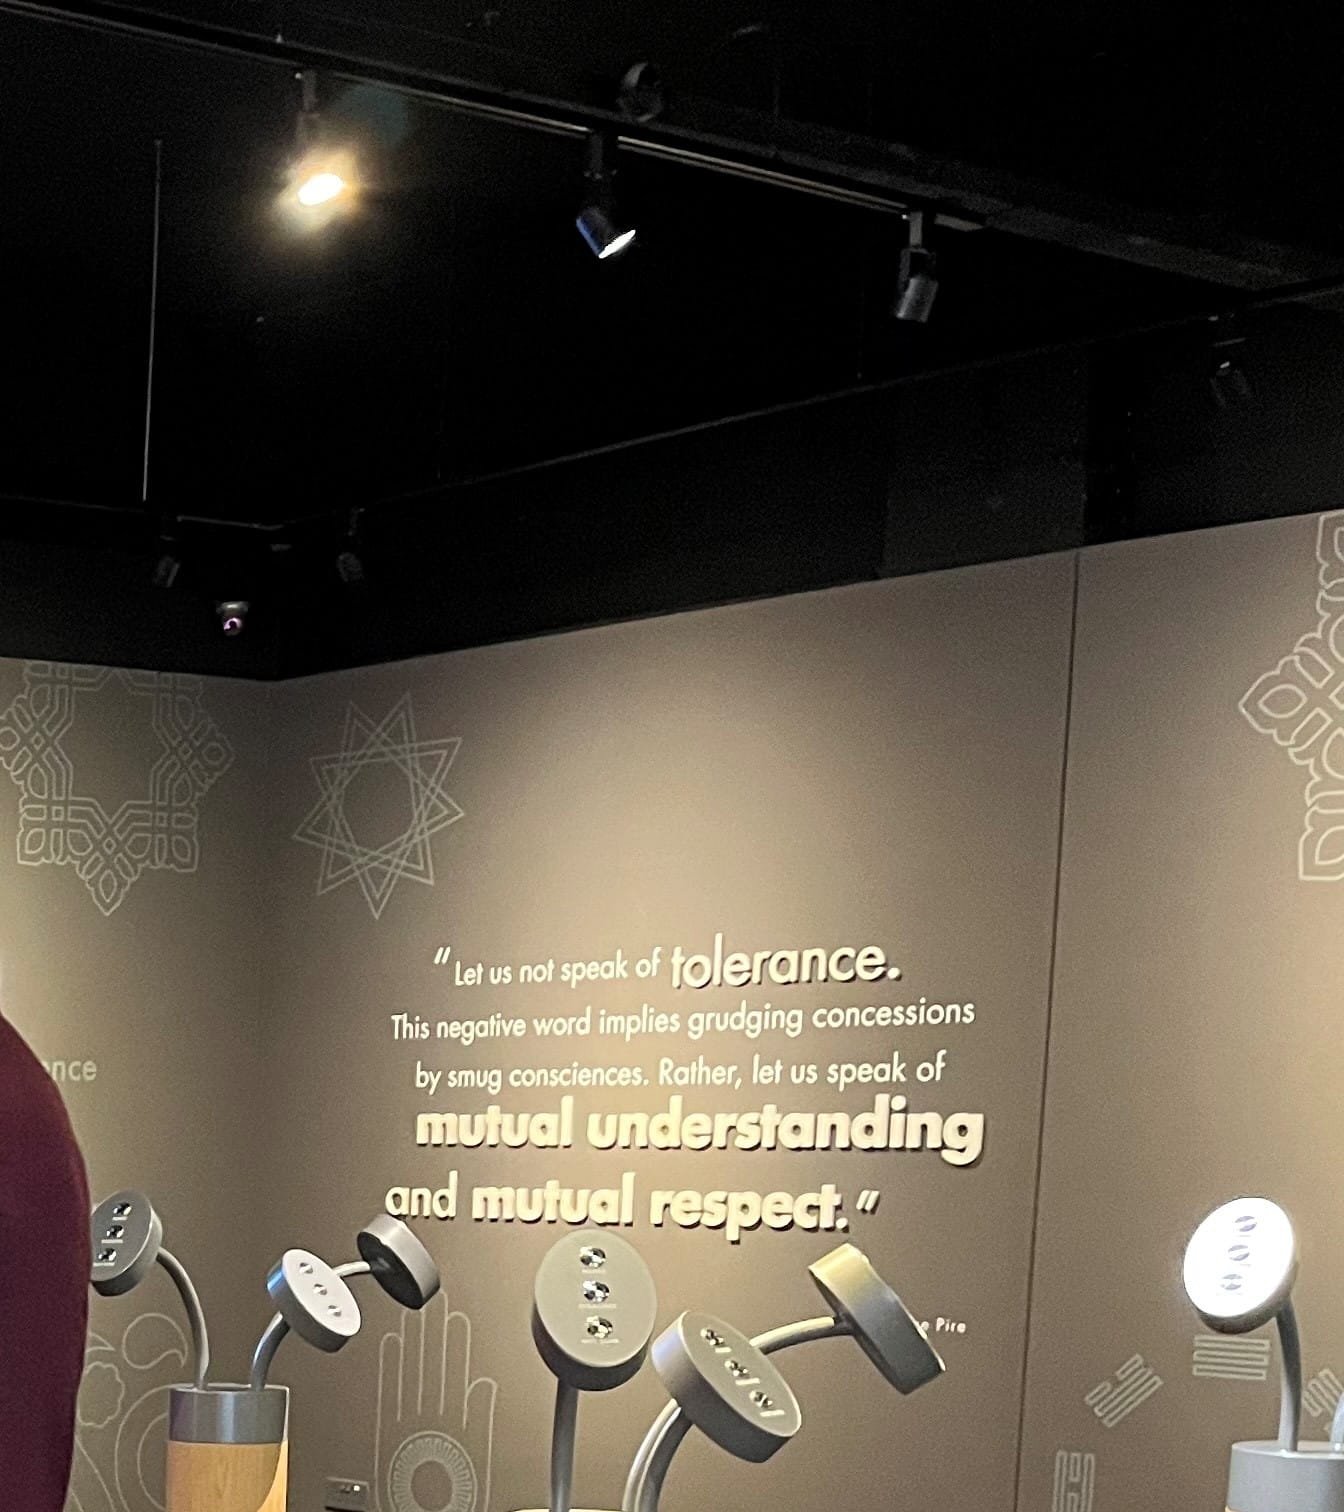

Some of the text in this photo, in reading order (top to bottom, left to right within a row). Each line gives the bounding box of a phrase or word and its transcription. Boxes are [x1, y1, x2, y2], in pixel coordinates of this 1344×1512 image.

[489, 964, 512, 985] us
[519, 958, 555, 983] not
[560, 949, 628, 989] speak
[635, 946, 662, 978] of
[671, 932, 902, 989] tolerance.
[391, 997, 975, 1046] This negative word implies grudging concessions
[415, 1049, 947, 1096] by smug consciences. Rather, let us speak of
[416, 1093, 985, 1166] mutual understanding
[385, 1170, 458, 1219] and
[472, 1172, 636, 1226] mutual
